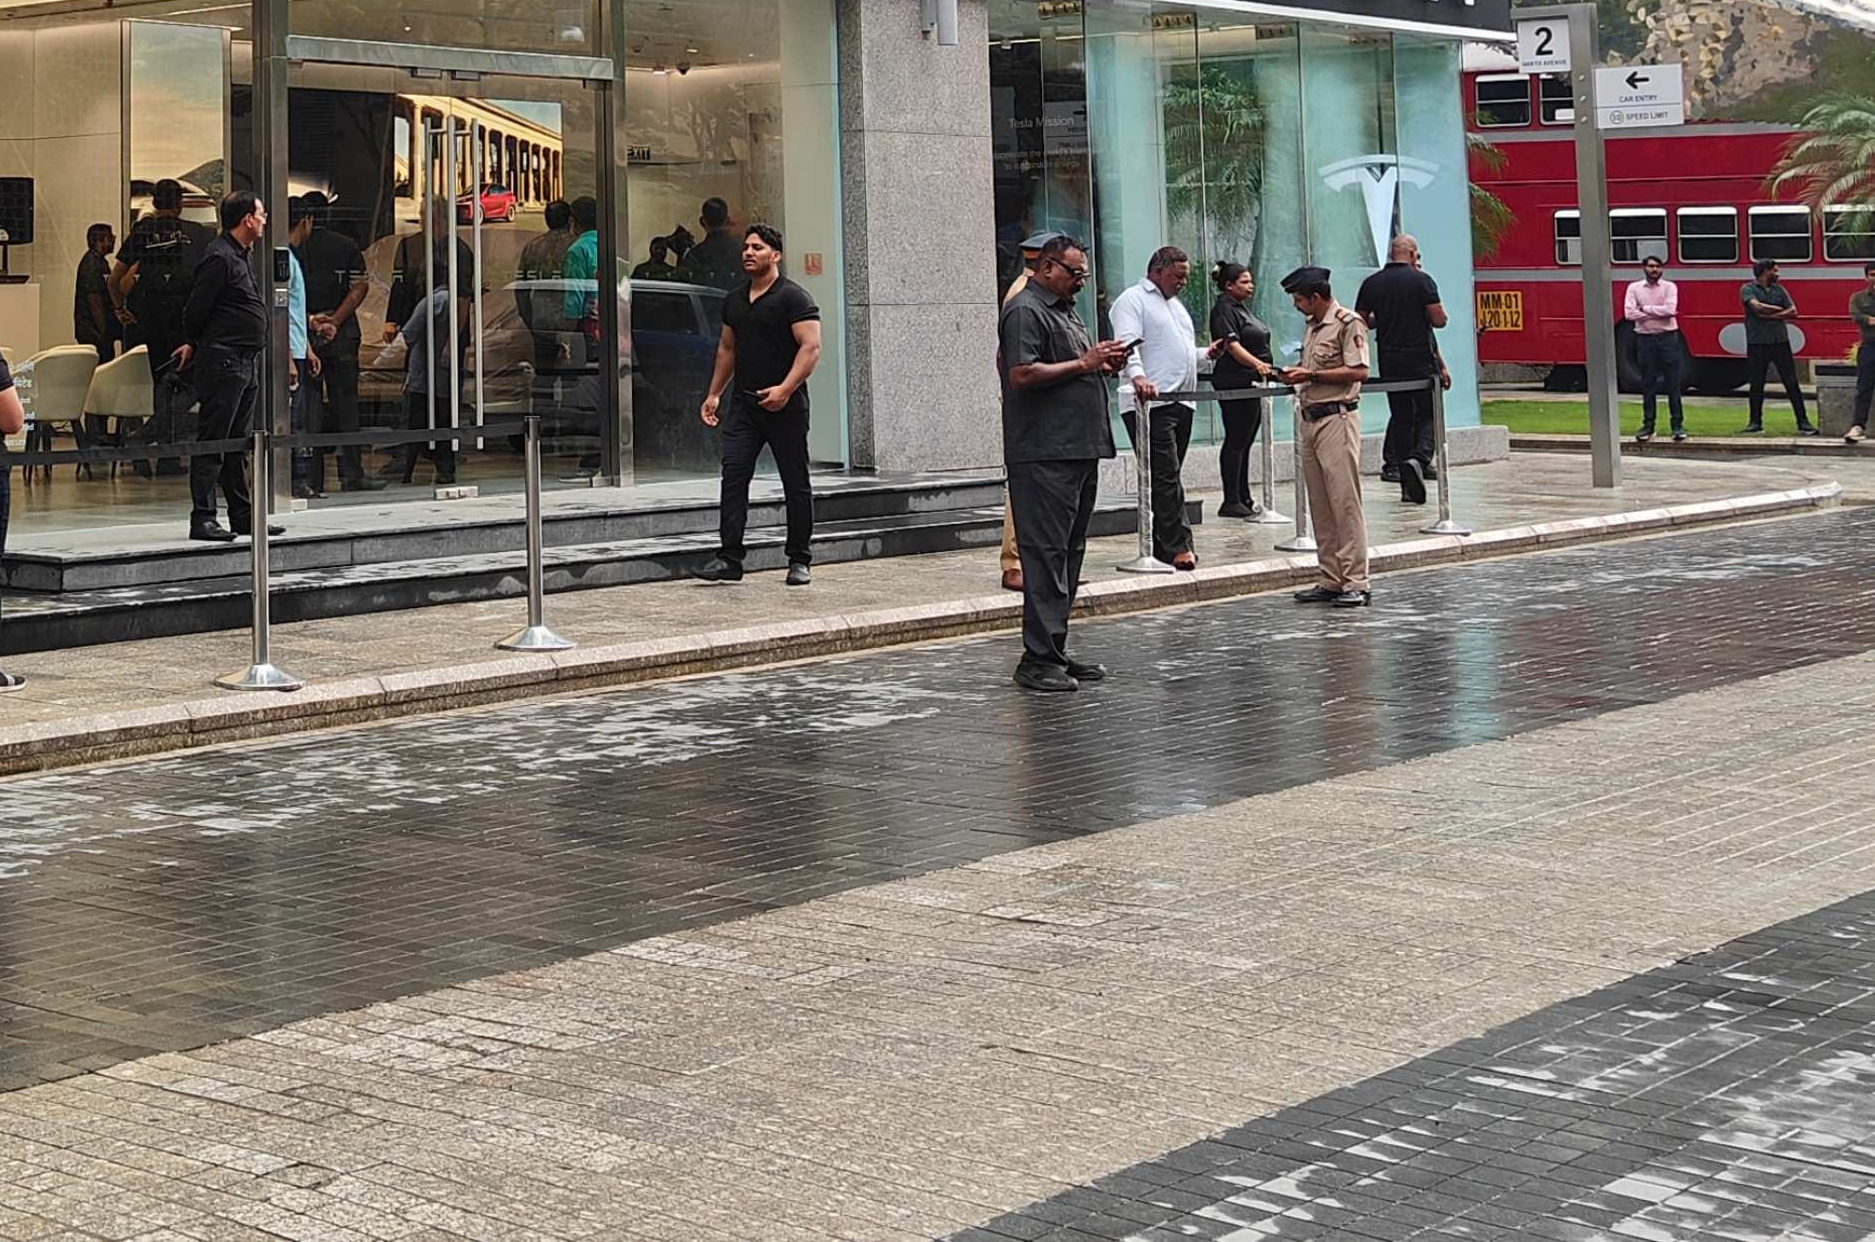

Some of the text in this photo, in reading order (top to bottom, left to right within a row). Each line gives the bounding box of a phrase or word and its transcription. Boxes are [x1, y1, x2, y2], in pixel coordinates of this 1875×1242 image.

[1534, 27, 1553, 56] 2
[1619, 94, 1657, 103] CAR ENTRY
[1626, 112, 1648, 121] SPEED
[1650, 111, 1668, 120] LIMIT
